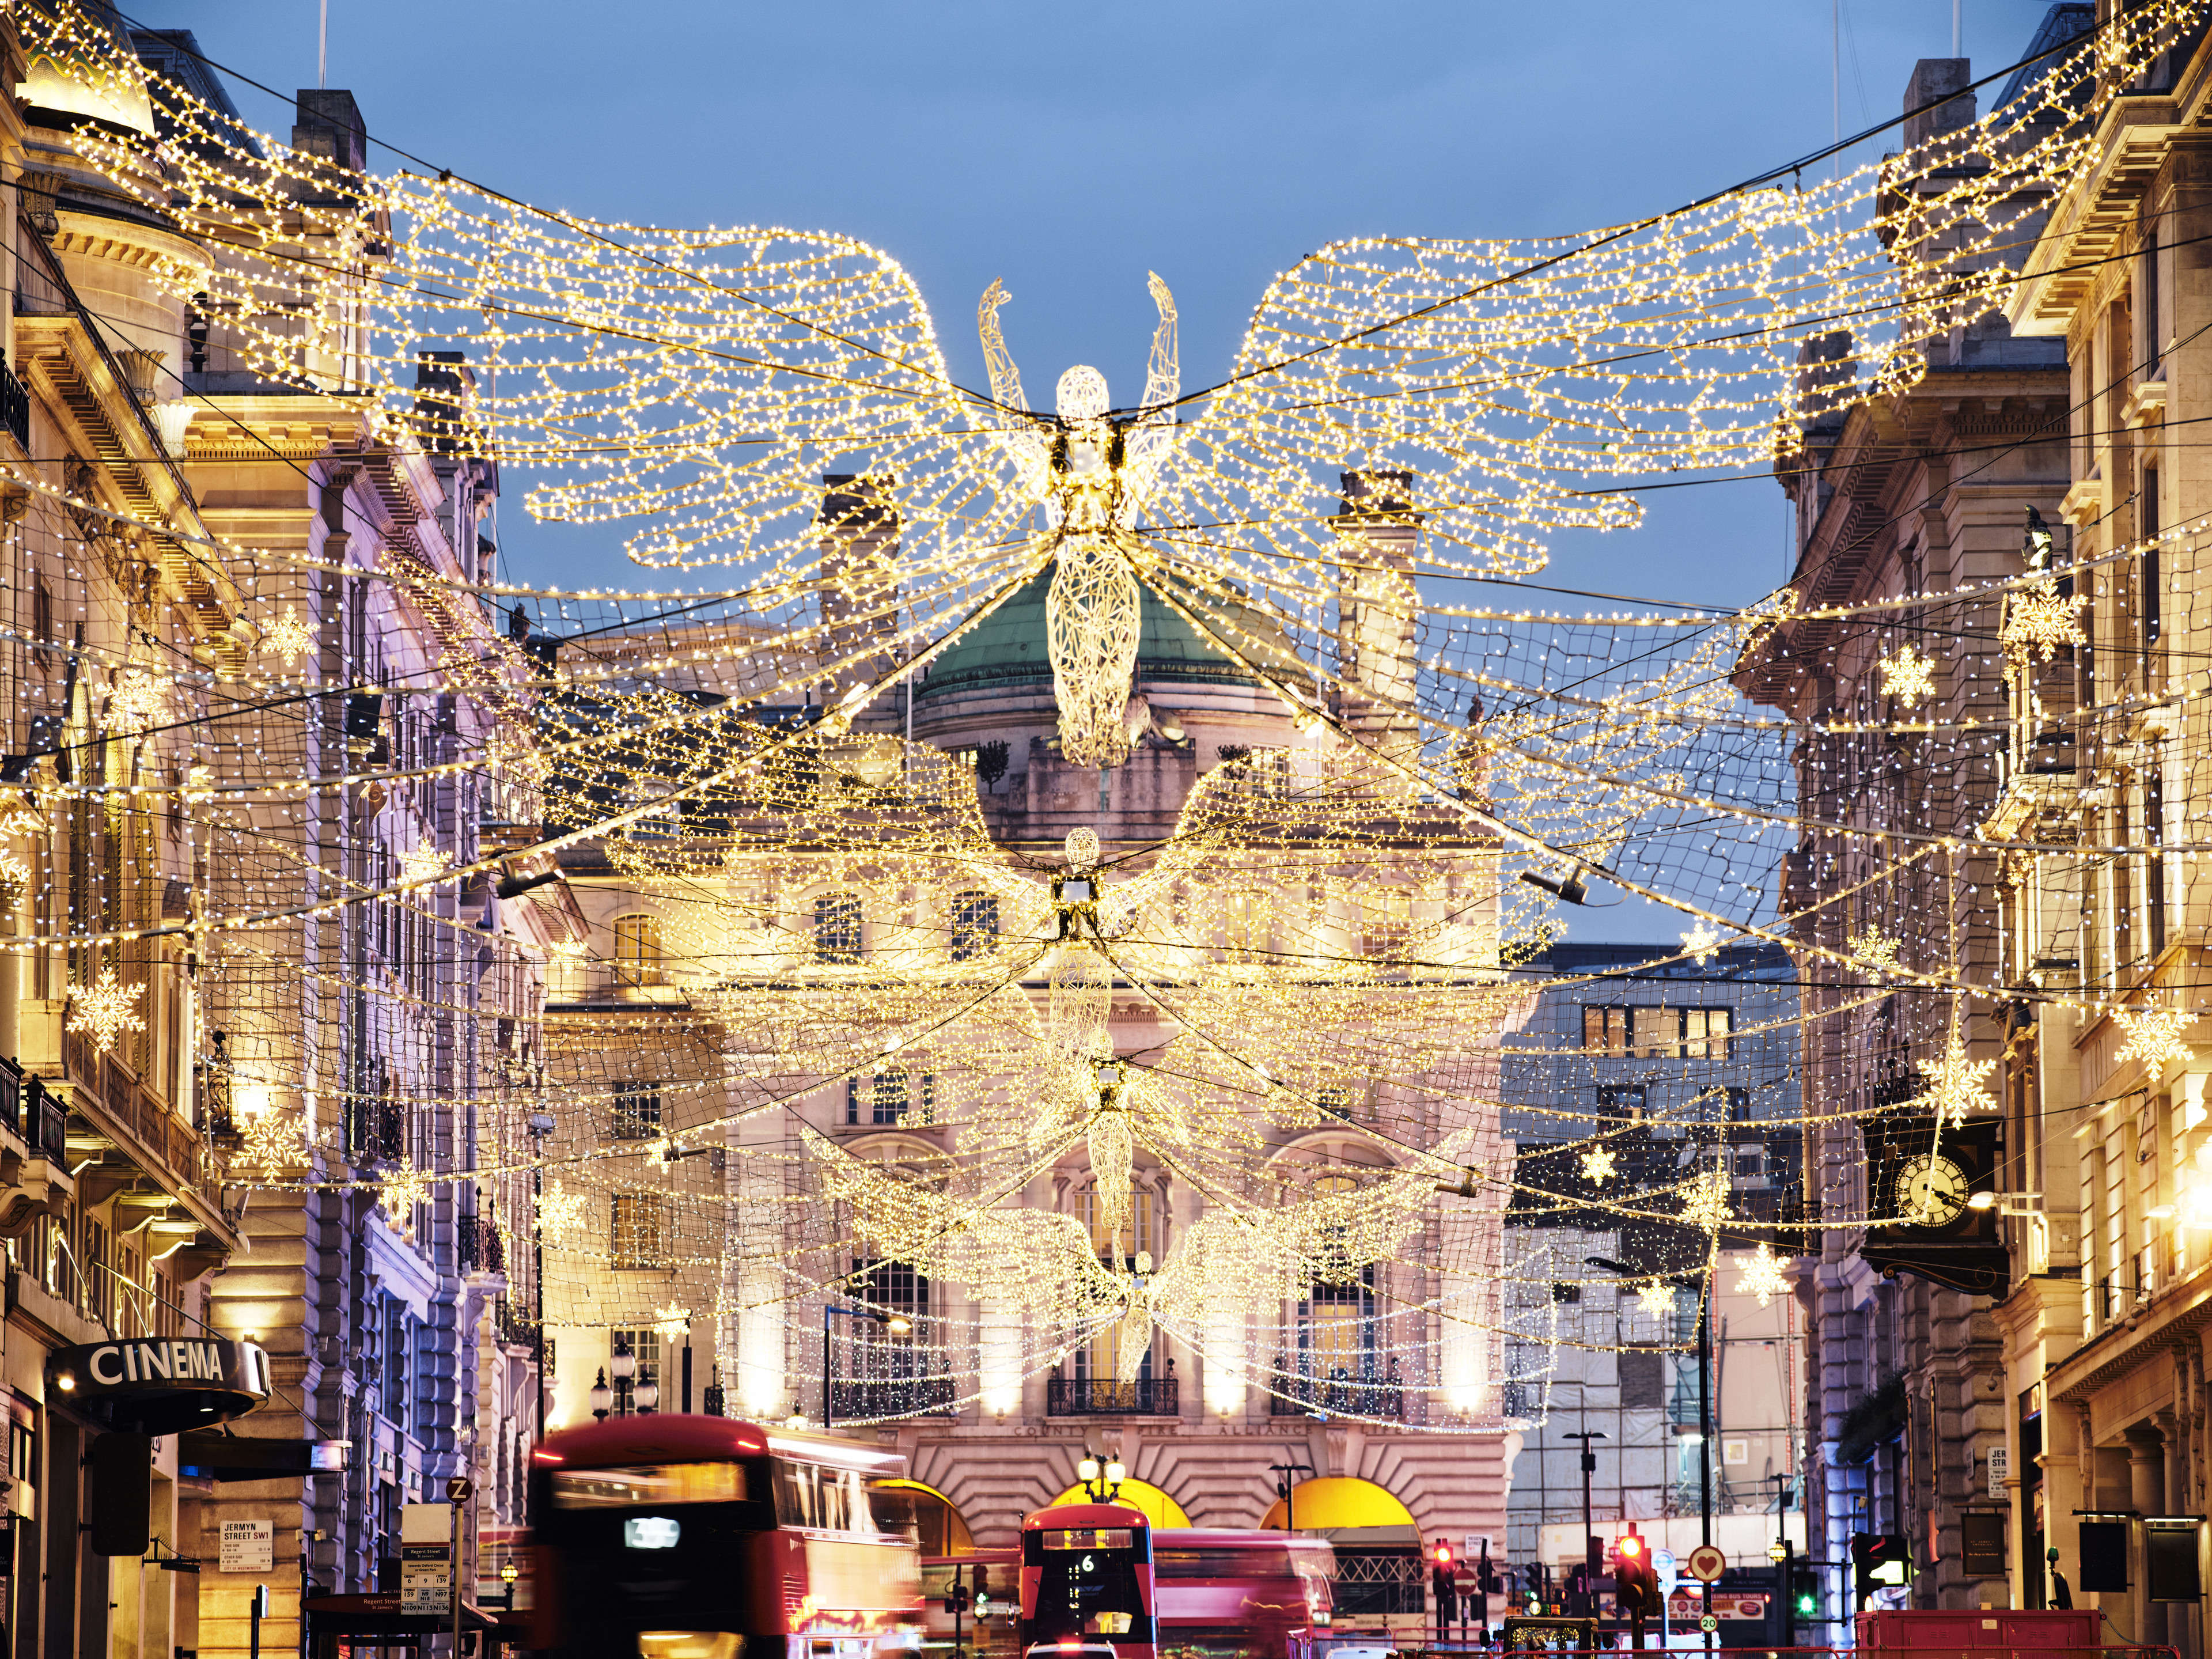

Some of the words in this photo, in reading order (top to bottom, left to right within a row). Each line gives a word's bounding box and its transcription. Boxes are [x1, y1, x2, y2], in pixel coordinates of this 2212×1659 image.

[89, 1342, 224, 1385] CINEMA
[1014, 1426, 1088, 1437] COUNTY
[1138, 1425, 1177, 1435] FIRE
[1219, 1425, 1312, 1435] ALLIANCE
[452, 1480, 467, 1498] Z
[1082, 1555, 1094, 1572] 6
[1702, 1619, 1716, 1627] 20
